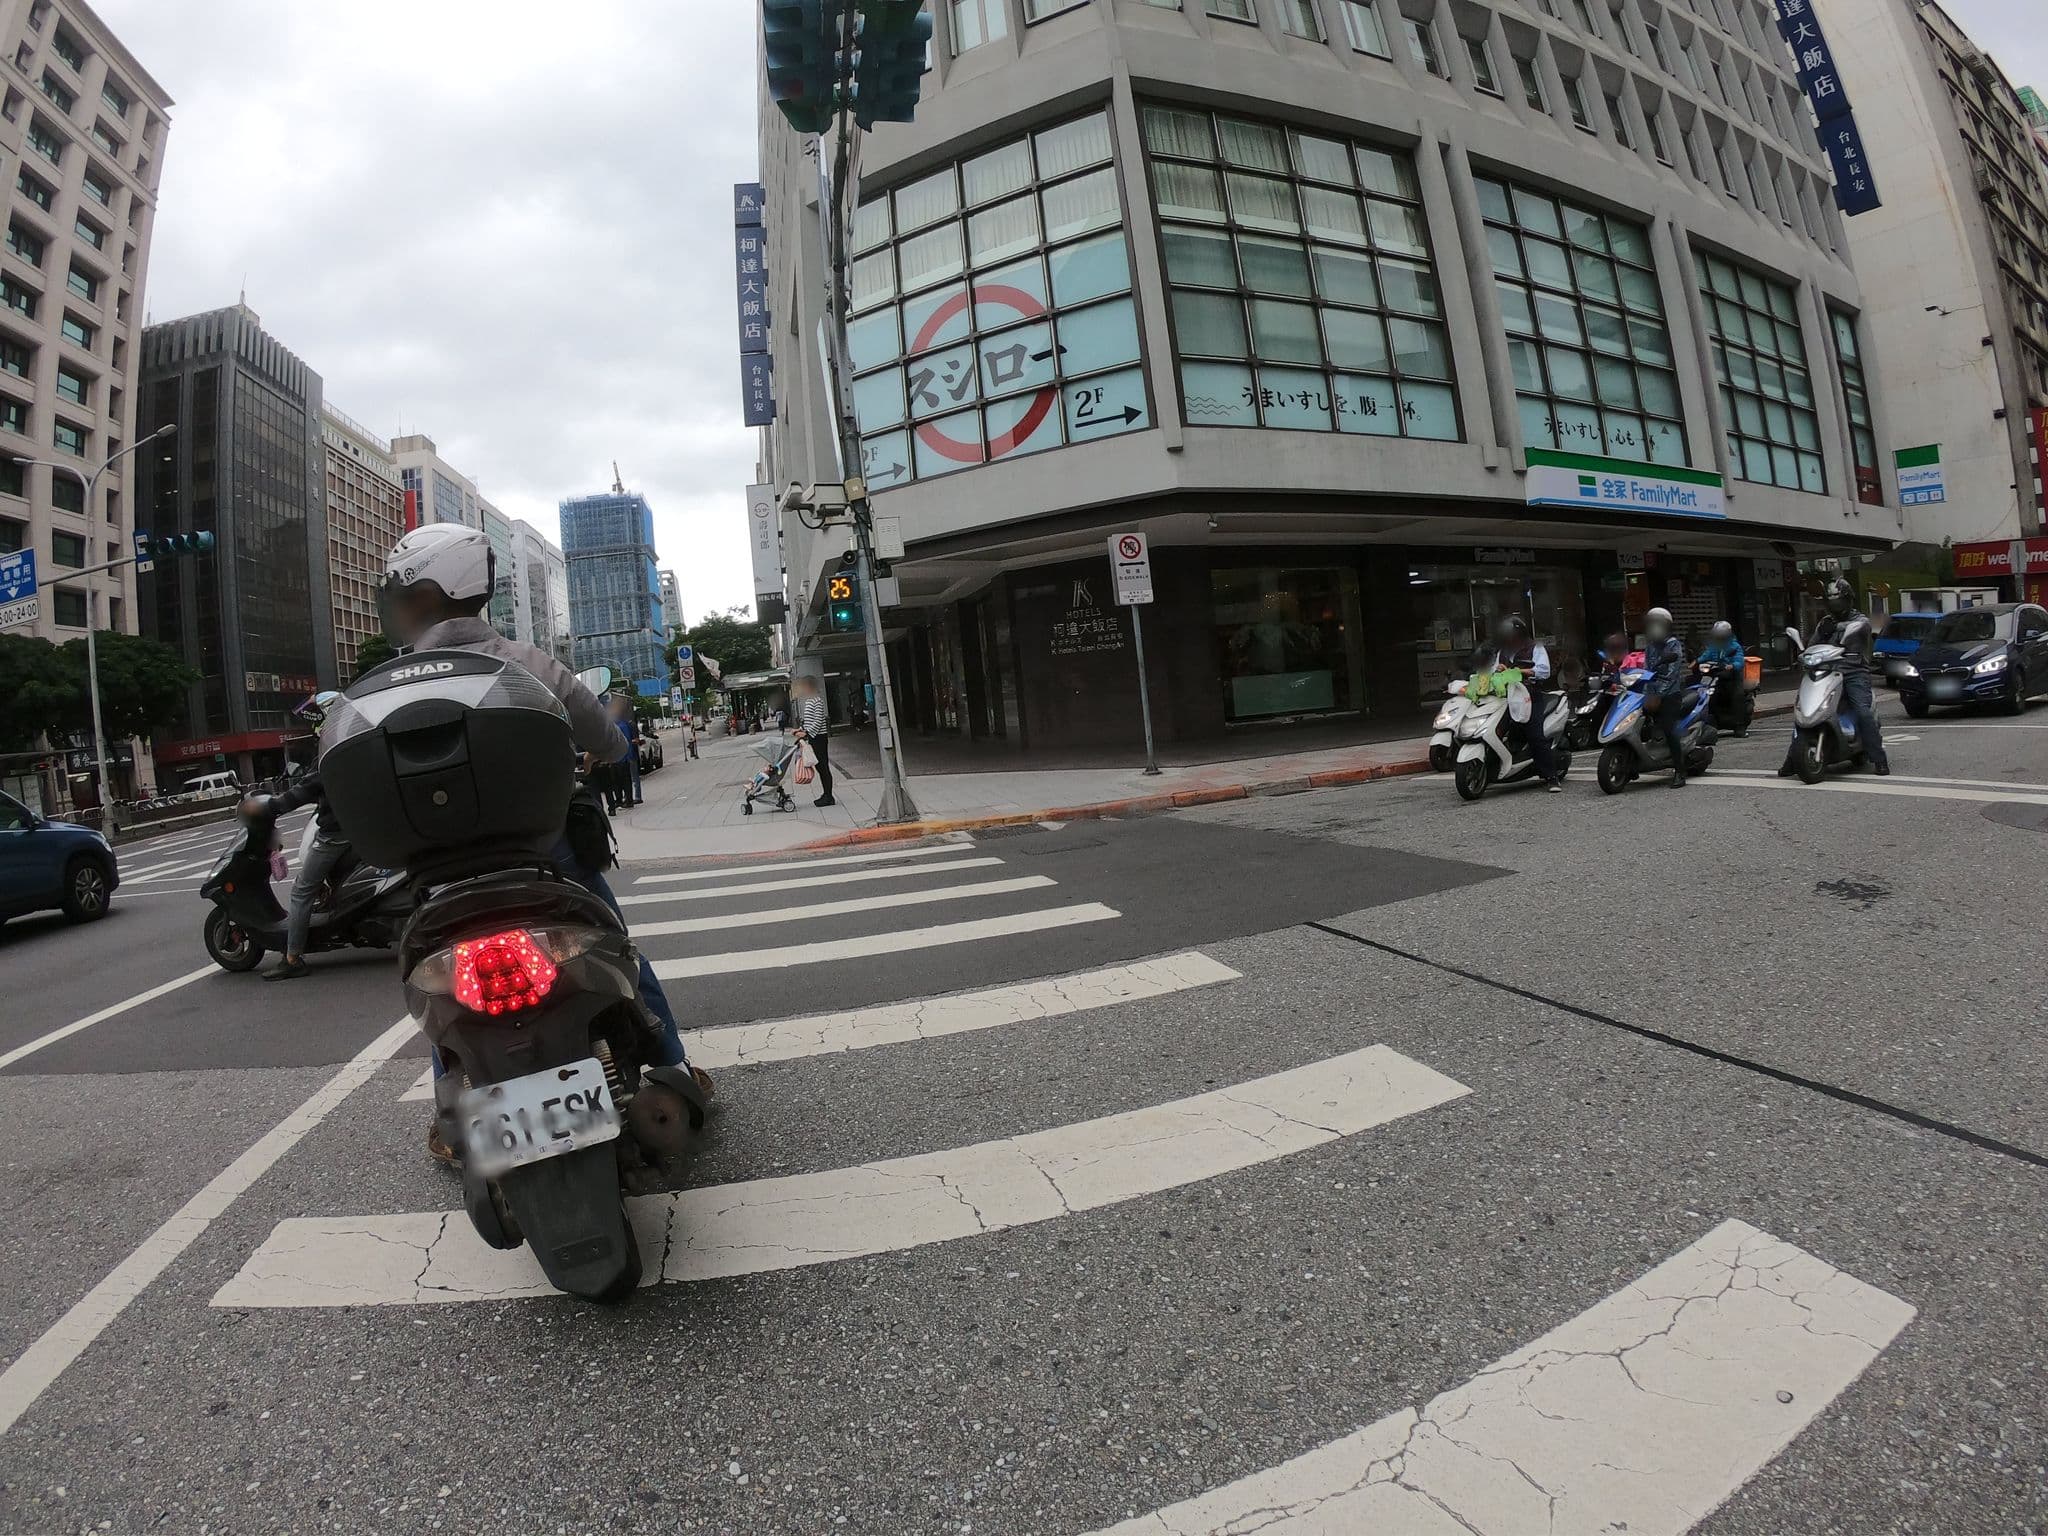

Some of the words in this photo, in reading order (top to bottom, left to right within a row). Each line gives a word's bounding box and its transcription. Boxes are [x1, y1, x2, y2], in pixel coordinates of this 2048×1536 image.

[1838, 131, 1865, 192] 台北長安
[740, 238, 761, 338] 柯達大飯店
[752, 365, 764, 411] 台北長安
[903, 343, 1068, 409] スシロー
[1074, 387, 1104, 417] 2F
[1899, 472, 1941, 481] FamilyMart
[1602, 479, 1627, 499] 全家
[1631, 481, 1697, 506] FamilyMart
[831, 578, 850, 599] 25
[1066, 607, 1101, 619] HOTELS
[1053, 617, 1118, 637] 柯達大飯店
[390, 662, 454, 682] SHAD
